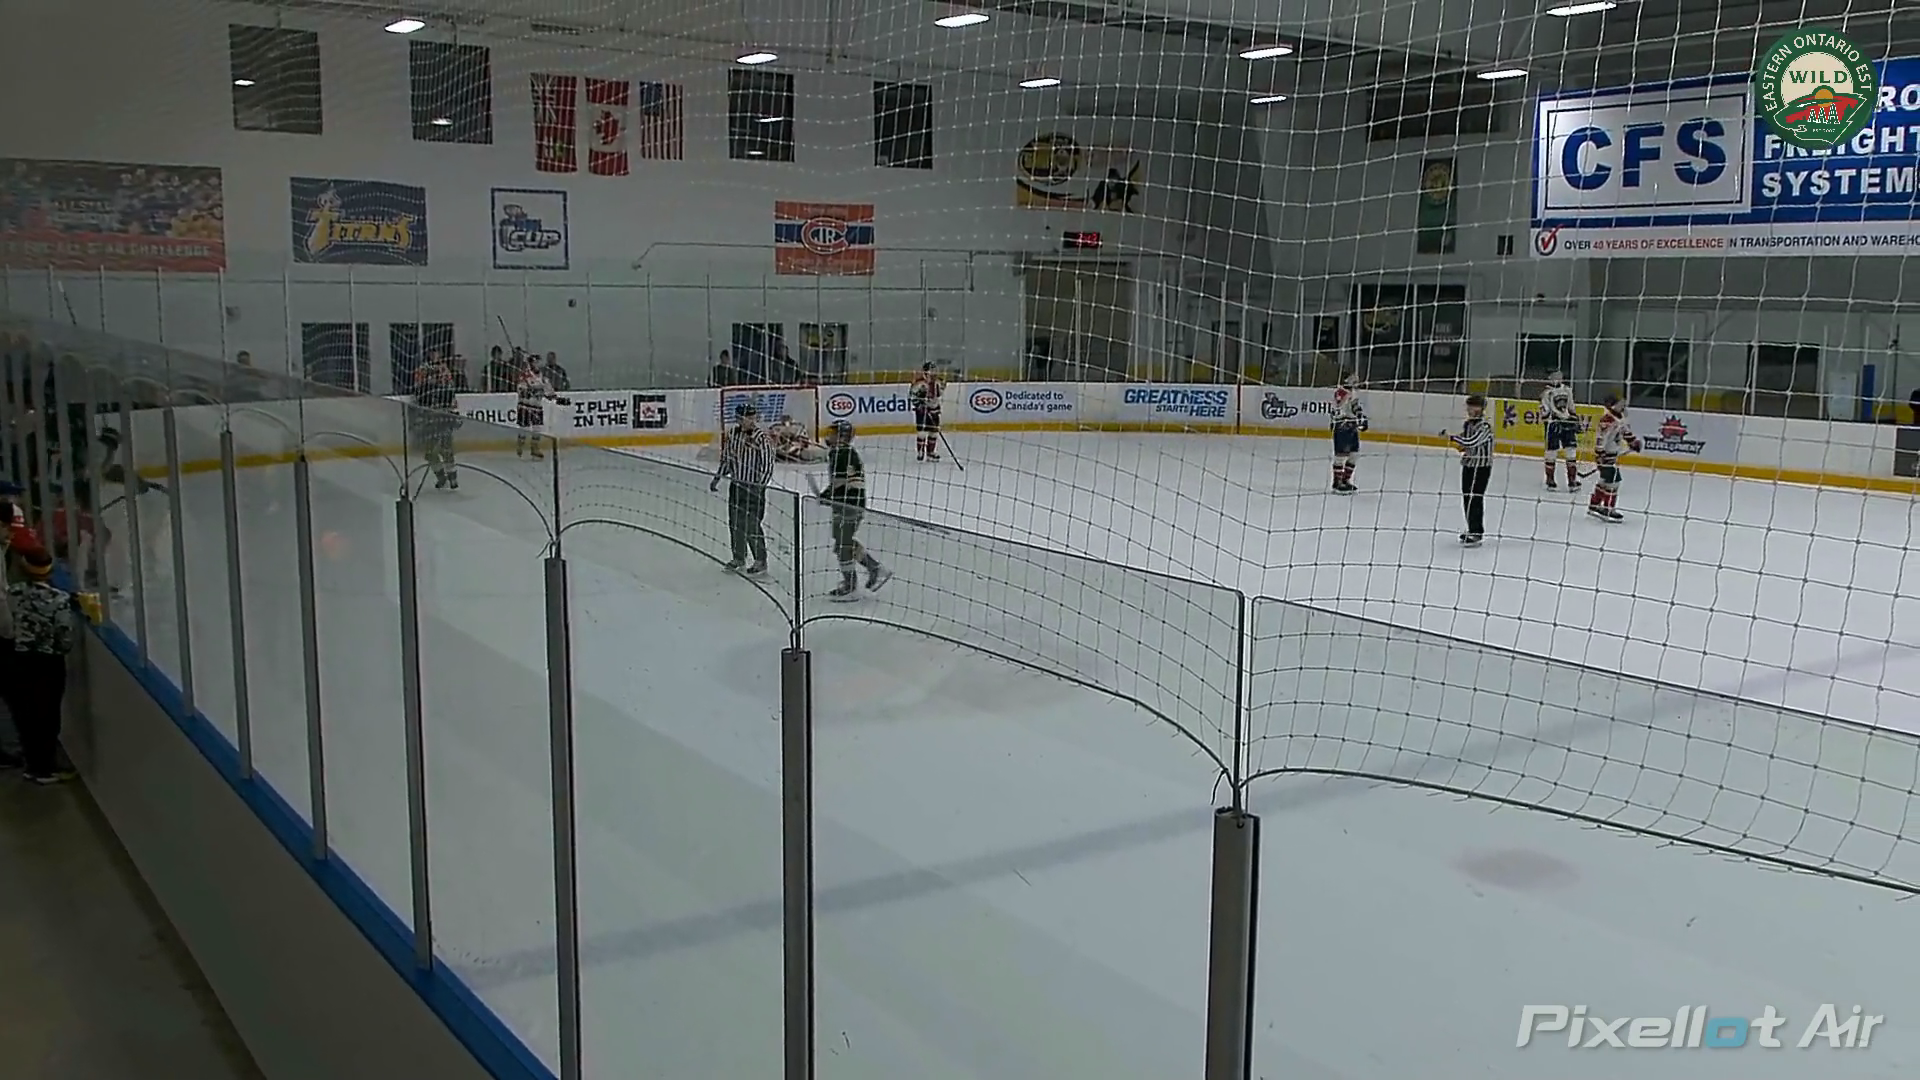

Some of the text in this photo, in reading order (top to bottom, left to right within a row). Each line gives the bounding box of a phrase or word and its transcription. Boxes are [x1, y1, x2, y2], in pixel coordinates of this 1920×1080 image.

[1561, 116, 1727, 191] CFS
[1762, 166, 1920, 198] SYSTEM
[1563, 239, 1591, 250] OVER
[1592, 240, 1604, 250] 40
[1606, 239, 1639, 250] YEARS
[1640, 239, 1655, 249] OF
[1656, 238, 1724, 249] EXCELLENCE
[1740, 235, 1842, 248] TRANSPORTATION
[1843, 235, 1868, 246] AND
[1005, 391, 1063, 400] Dedicated to
[1124, 388, 1229, 406] GREATNESS
[575, 400, 628, 414] I PLAY
[1005, 400, 1073, 413] Canada's game
[1155, 405, 1227, 417] STARTS HERE
[573, 413, 628, 428] IN THE
